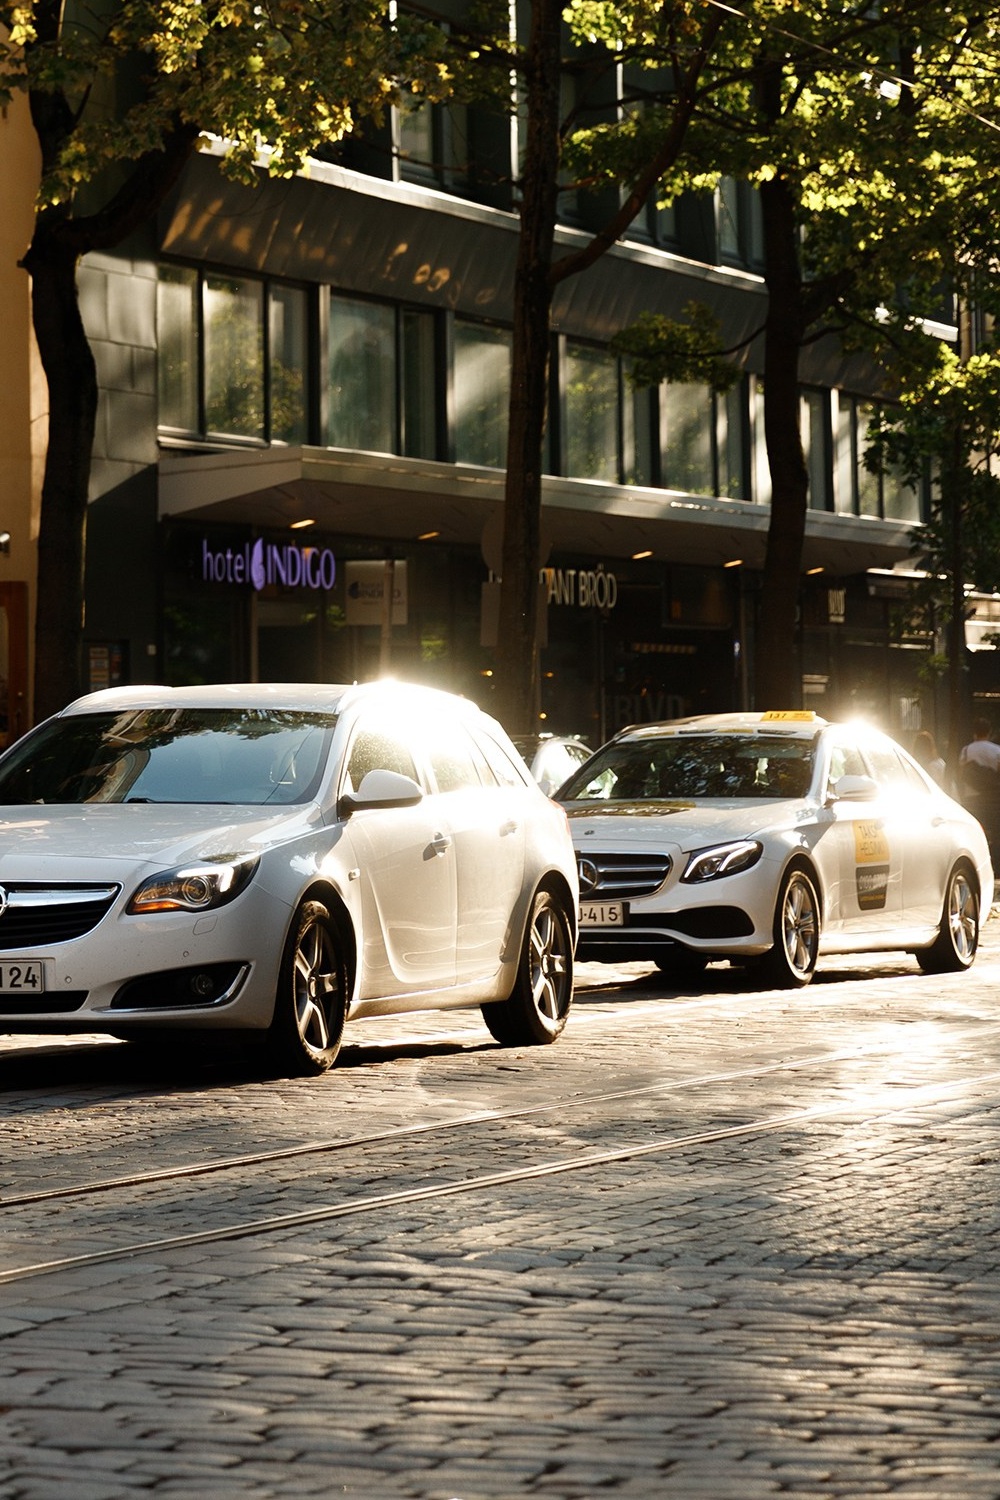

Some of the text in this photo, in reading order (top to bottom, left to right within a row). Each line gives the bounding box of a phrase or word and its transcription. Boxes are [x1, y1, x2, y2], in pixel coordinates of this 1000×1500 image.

[202, 537, 336, 590] hotel INDIGO
[578, 562, 618, 609] BRÖD
